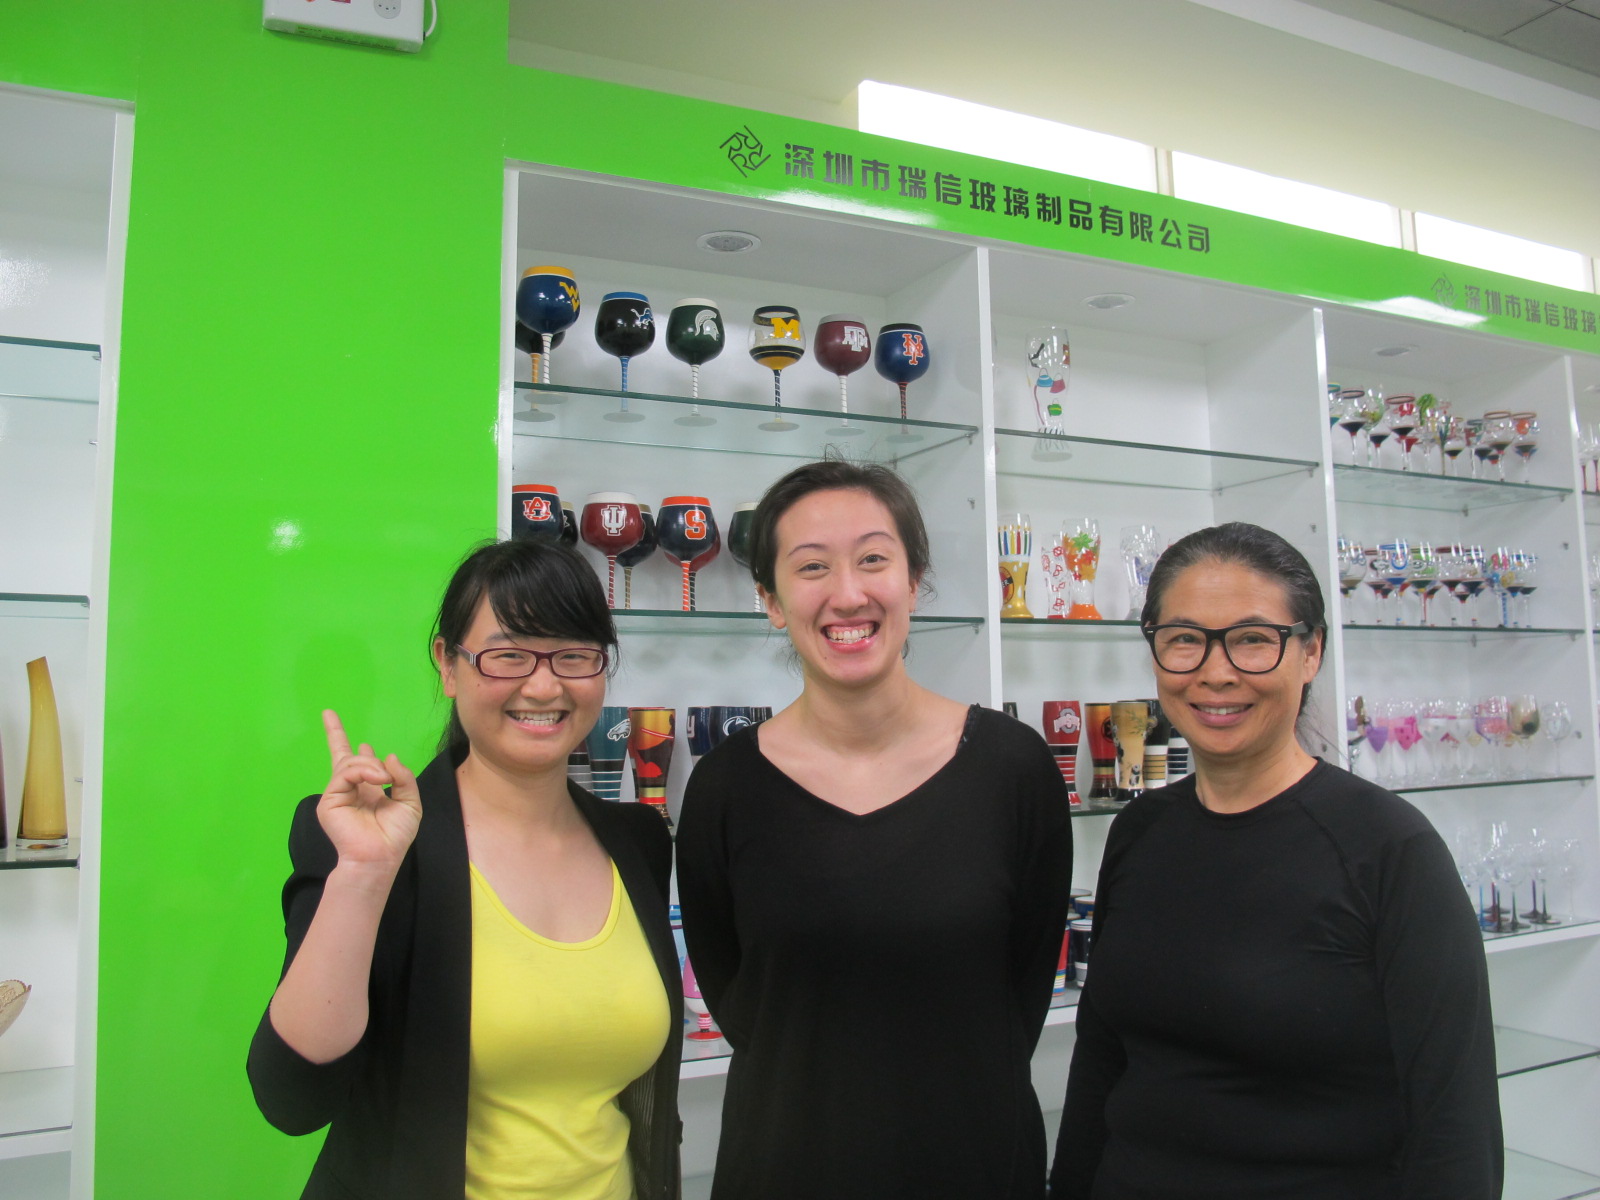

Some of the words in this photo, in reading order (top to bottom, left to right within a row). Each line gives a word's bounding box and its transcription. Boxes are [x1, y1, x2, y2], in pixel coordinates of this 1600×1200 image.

[785, 142, 1211, 254] 深圳市瑞信玻璃制品有限公司
[770, 317, 800, 341] M
[1464, 284, 1600, 335] 深圳市瑞信玻璃
[684, 509, 707, 540] S
